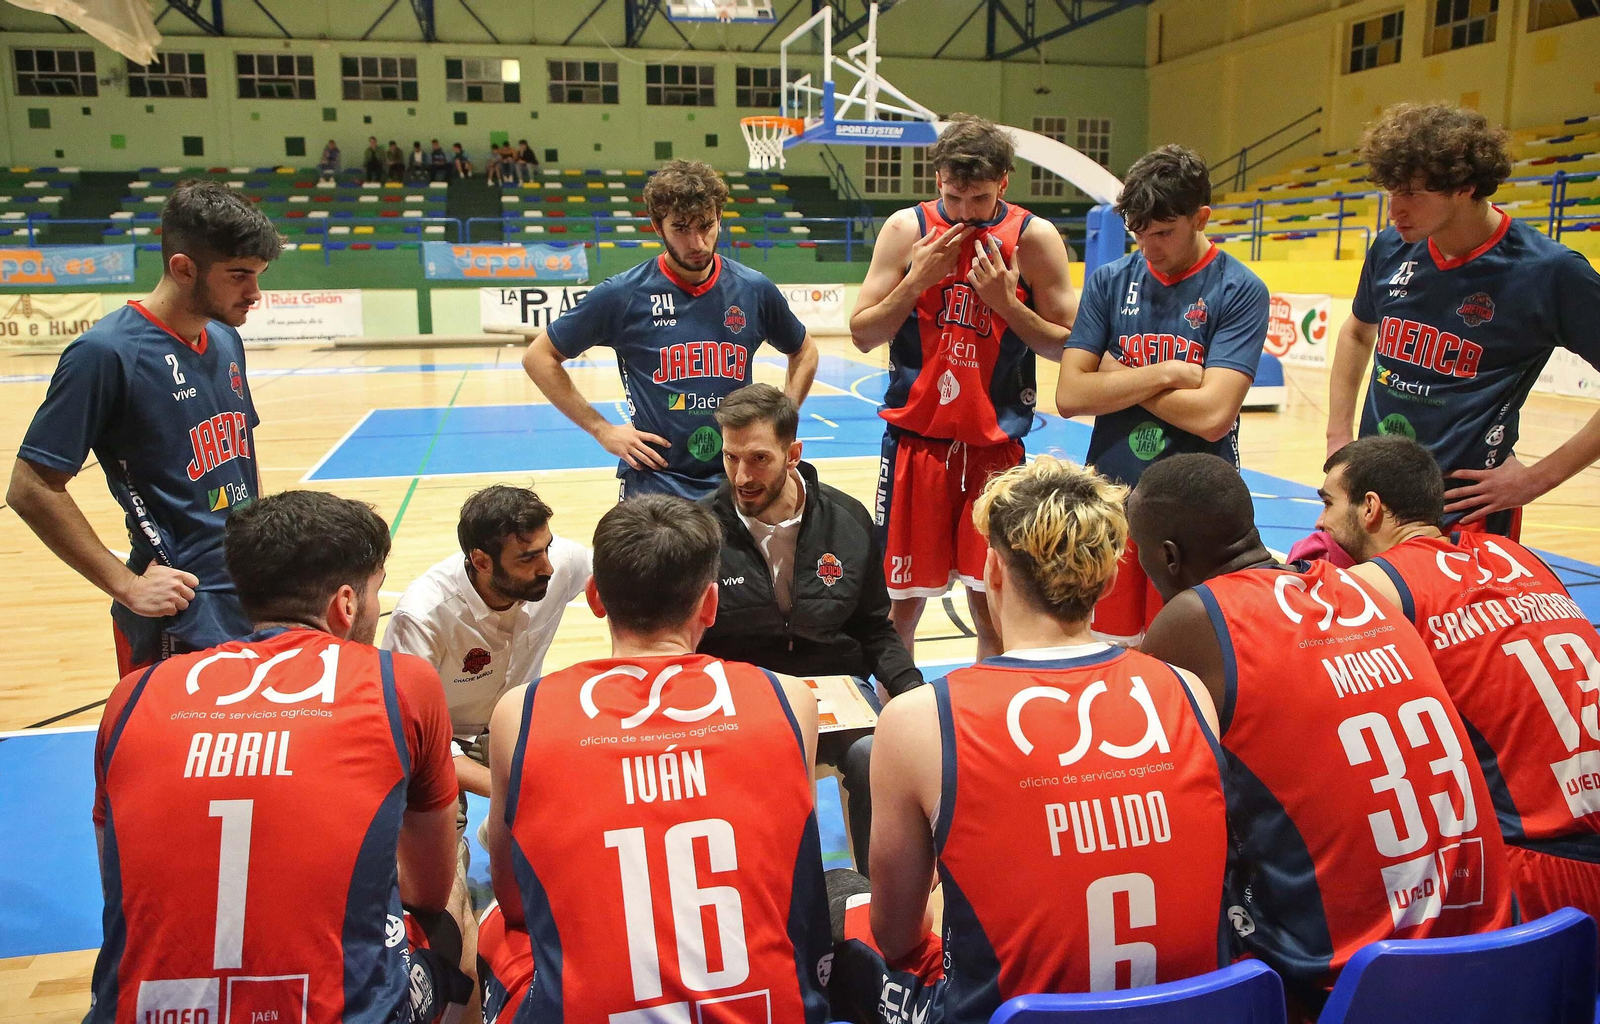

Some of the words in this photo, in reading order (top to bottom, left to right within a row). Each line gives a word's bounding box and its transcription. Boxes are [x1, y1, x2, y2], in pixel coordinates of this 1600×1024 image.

[836, 125, 868, 135] SPORT
[868, 126, 904, 137] SYSTEM
[454, 250, 572, 275] deportes
[1389, 261, 1418, 285] 25
[271, 293, 299, 305] Ruiz
[302, 292, 342, 304] Galán
[501, 289, 518, 305] LA
[650, 293, 676, 316] 24
[1126, 281, 1139, 305] 5
[653, 318, 677, 327] vive
[1120, 306, 1140, 316] vive
[29, 323, 39, 336] e
[50, 319, 100, 336] HIJO
[1377, 315, 1484, 379] JAENCB
[164, 353, 186, 385] 2
[652, 341, 748, 385] JAENCB
[172, 386, 197, 402] vive
[186, 412, 251, 482] JAENC
[722, 576, 745, 587] vive
[890, 555, 913, 584] 22
[1427, 599, 1515, 650] SANTA
[1321, 643, 1414, 699] MAYOT
[170, 708, 207, 721] oficina
[209, 710, 226, 720] de
[229, 708, 278, 720] servicios
[280, 707, 333, 719] agrícolas
[580, 734, 618, 747] oficina
[621, 734, 637, 743] de
[640, 731, 687, 742] servicios
[689, 722, 739, 739] agrícolas
[183, 730, 293, 778] ABRIL
[621, 744, 707, 805] IVÁN
[1019, 775, 1060, 789] oficina
[1063, 773, 1078, 785] de
[1080, 769, 1127, 783] servicios
[1129, 760, 1175, 778] agrícolas
[1337, 696, 1478, 858] 33
[1044, 790, 1172, 857] PULIDO
[208, 799, 254, 970] 1
[603, 818, 750, 1002] 16
[1085, 872, 1157, 993] 6
[251, 1010, 279, 1024] JAÉN
